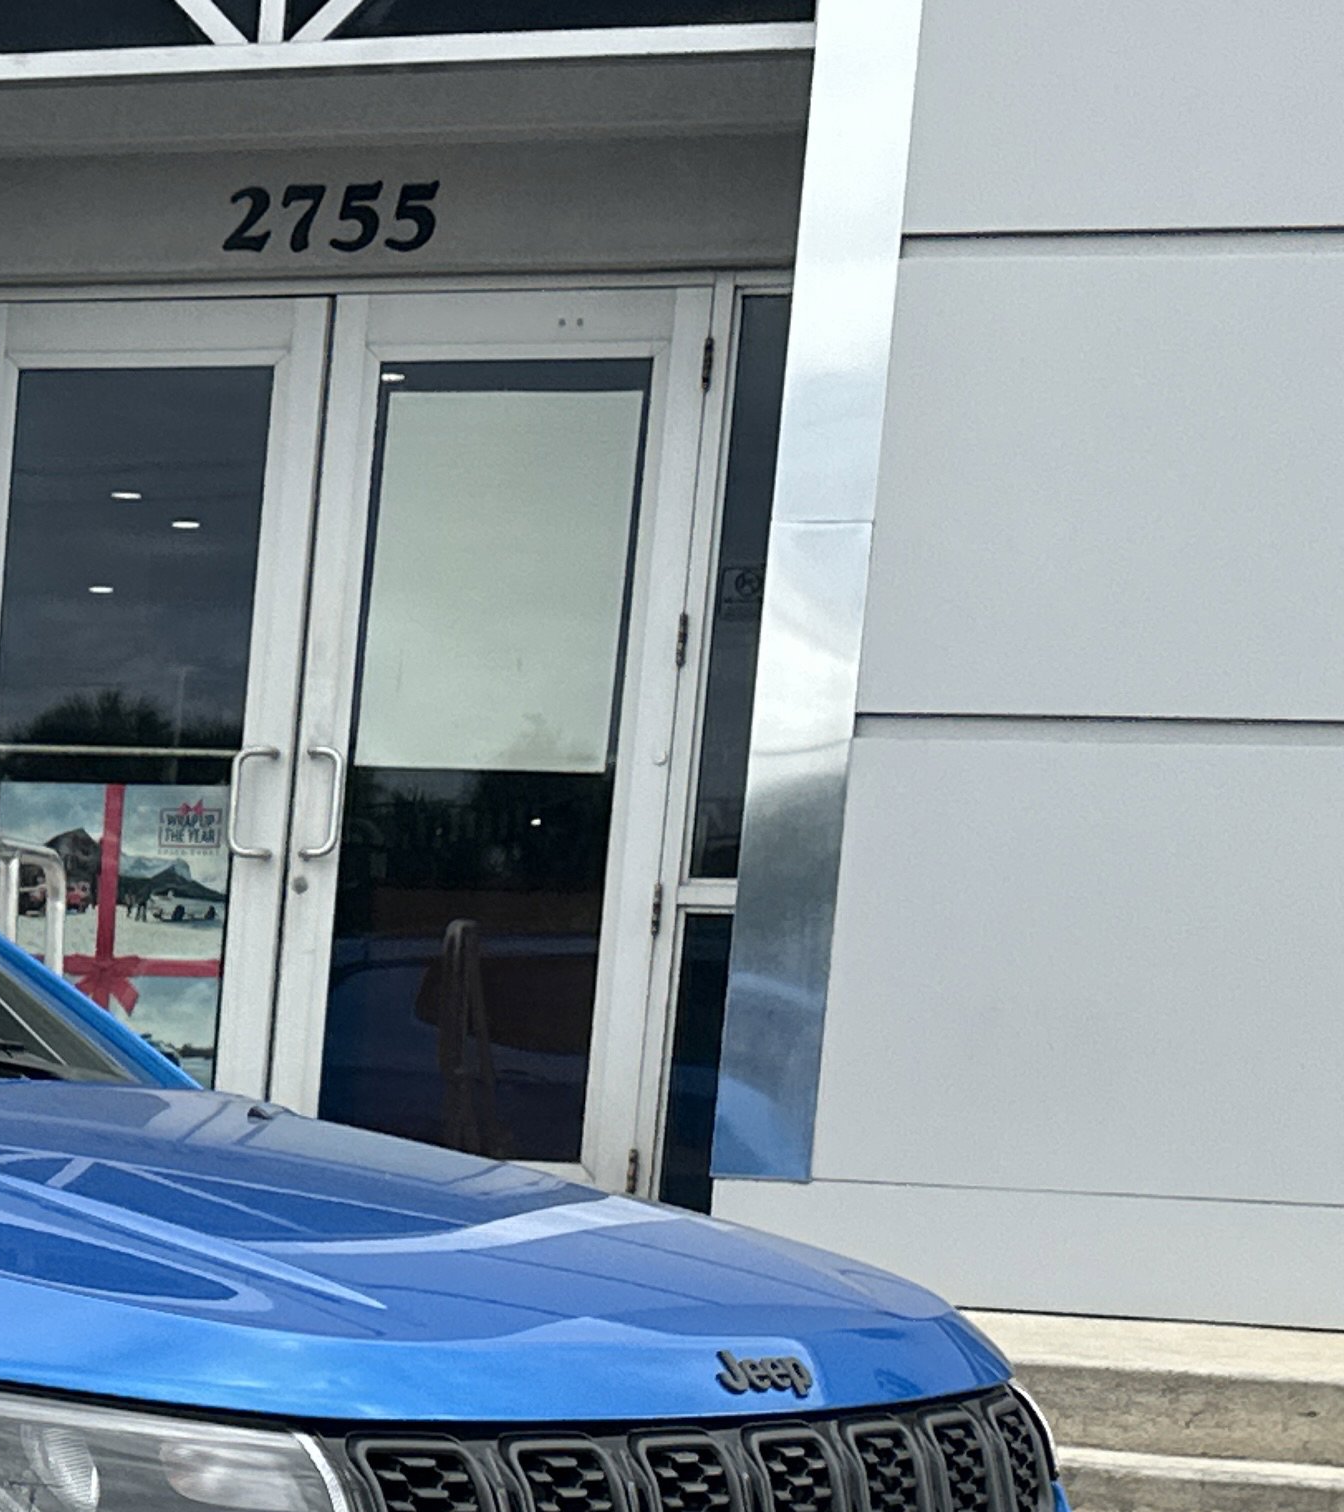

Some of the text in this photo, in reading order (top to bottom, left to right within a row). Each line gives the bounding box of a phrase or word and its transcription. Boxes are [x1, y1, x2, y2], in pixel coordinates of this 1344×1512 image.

[222, 180, 440, 253] 2755
[164, 828, 215, 844] THE YEAR
[165, 814, 198, 829] WRAP
[715, 1349, 812, 1399] Jeep
